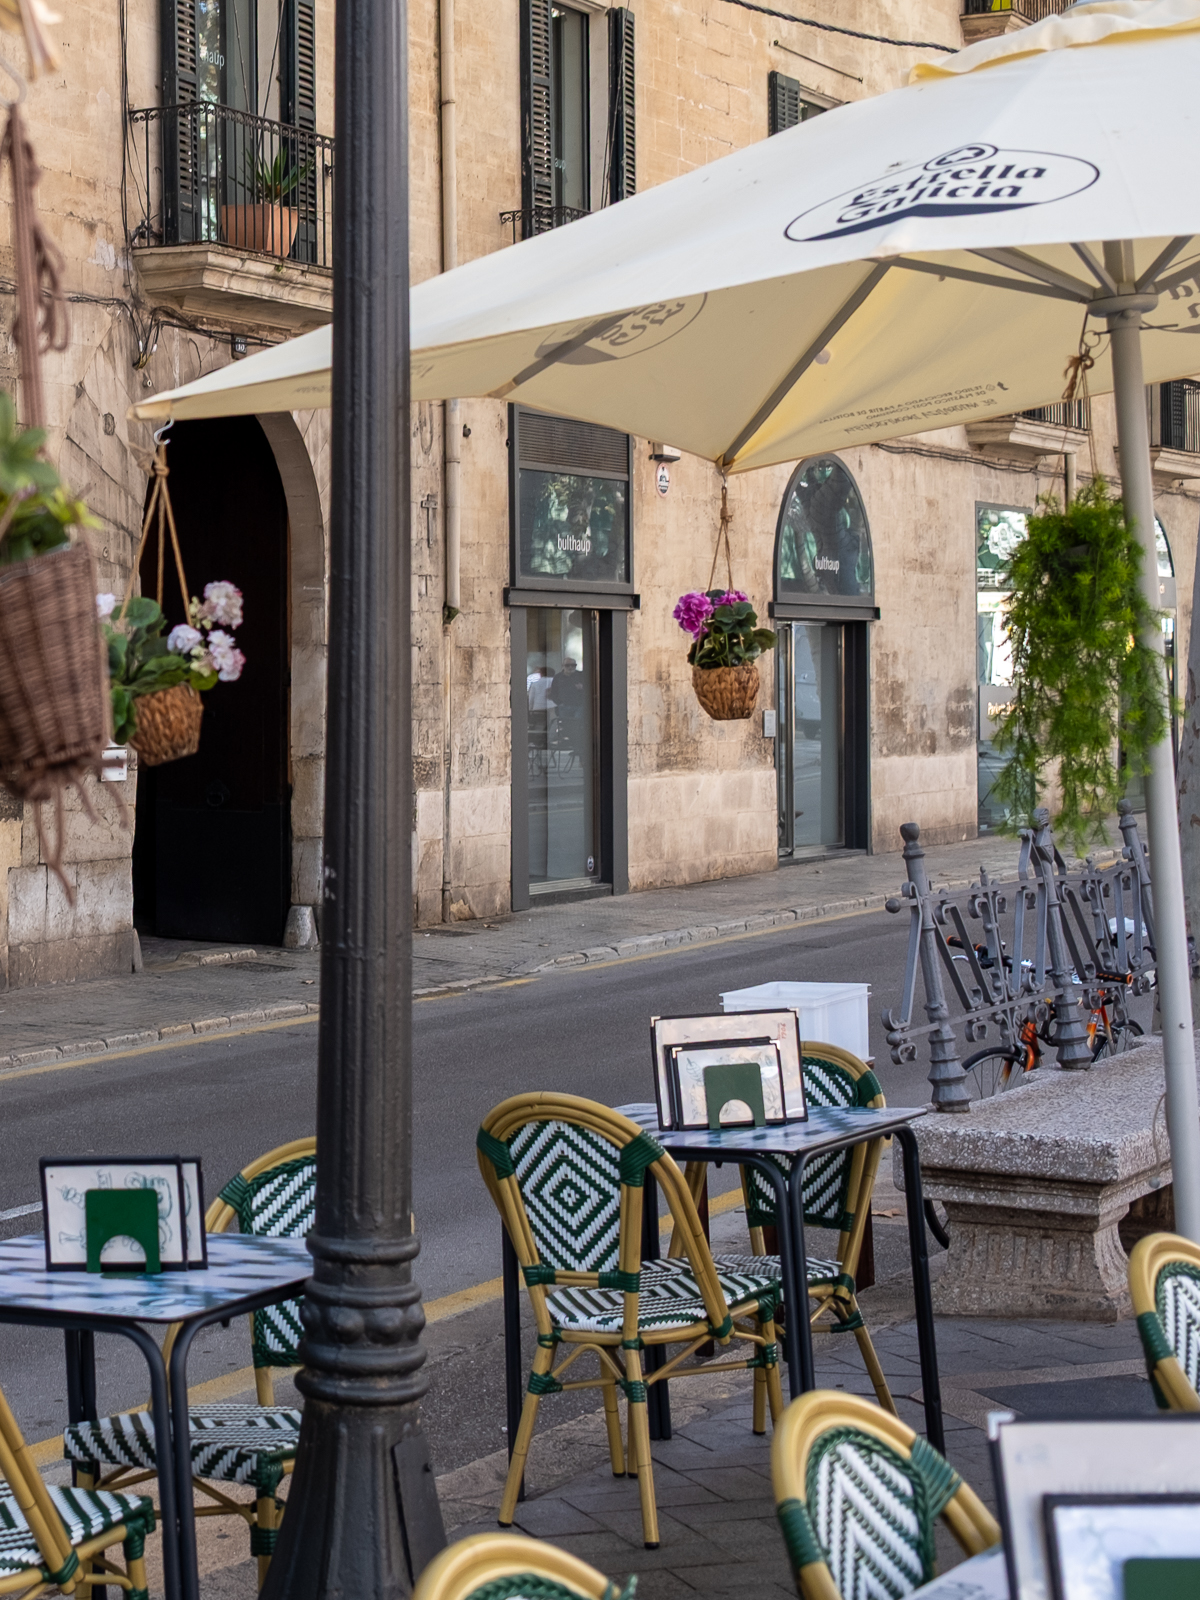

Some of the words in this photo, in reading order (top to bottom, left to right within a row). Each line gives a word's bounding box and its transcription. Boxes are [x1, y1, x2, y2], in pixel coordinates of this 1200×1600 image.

[850, 163, 1048, 206] Estrella
[836, 180, 1025, 224] Galicia
[557, 533, 591, 557] bulthaup
[814, 555, 840, 575] bulthaup
